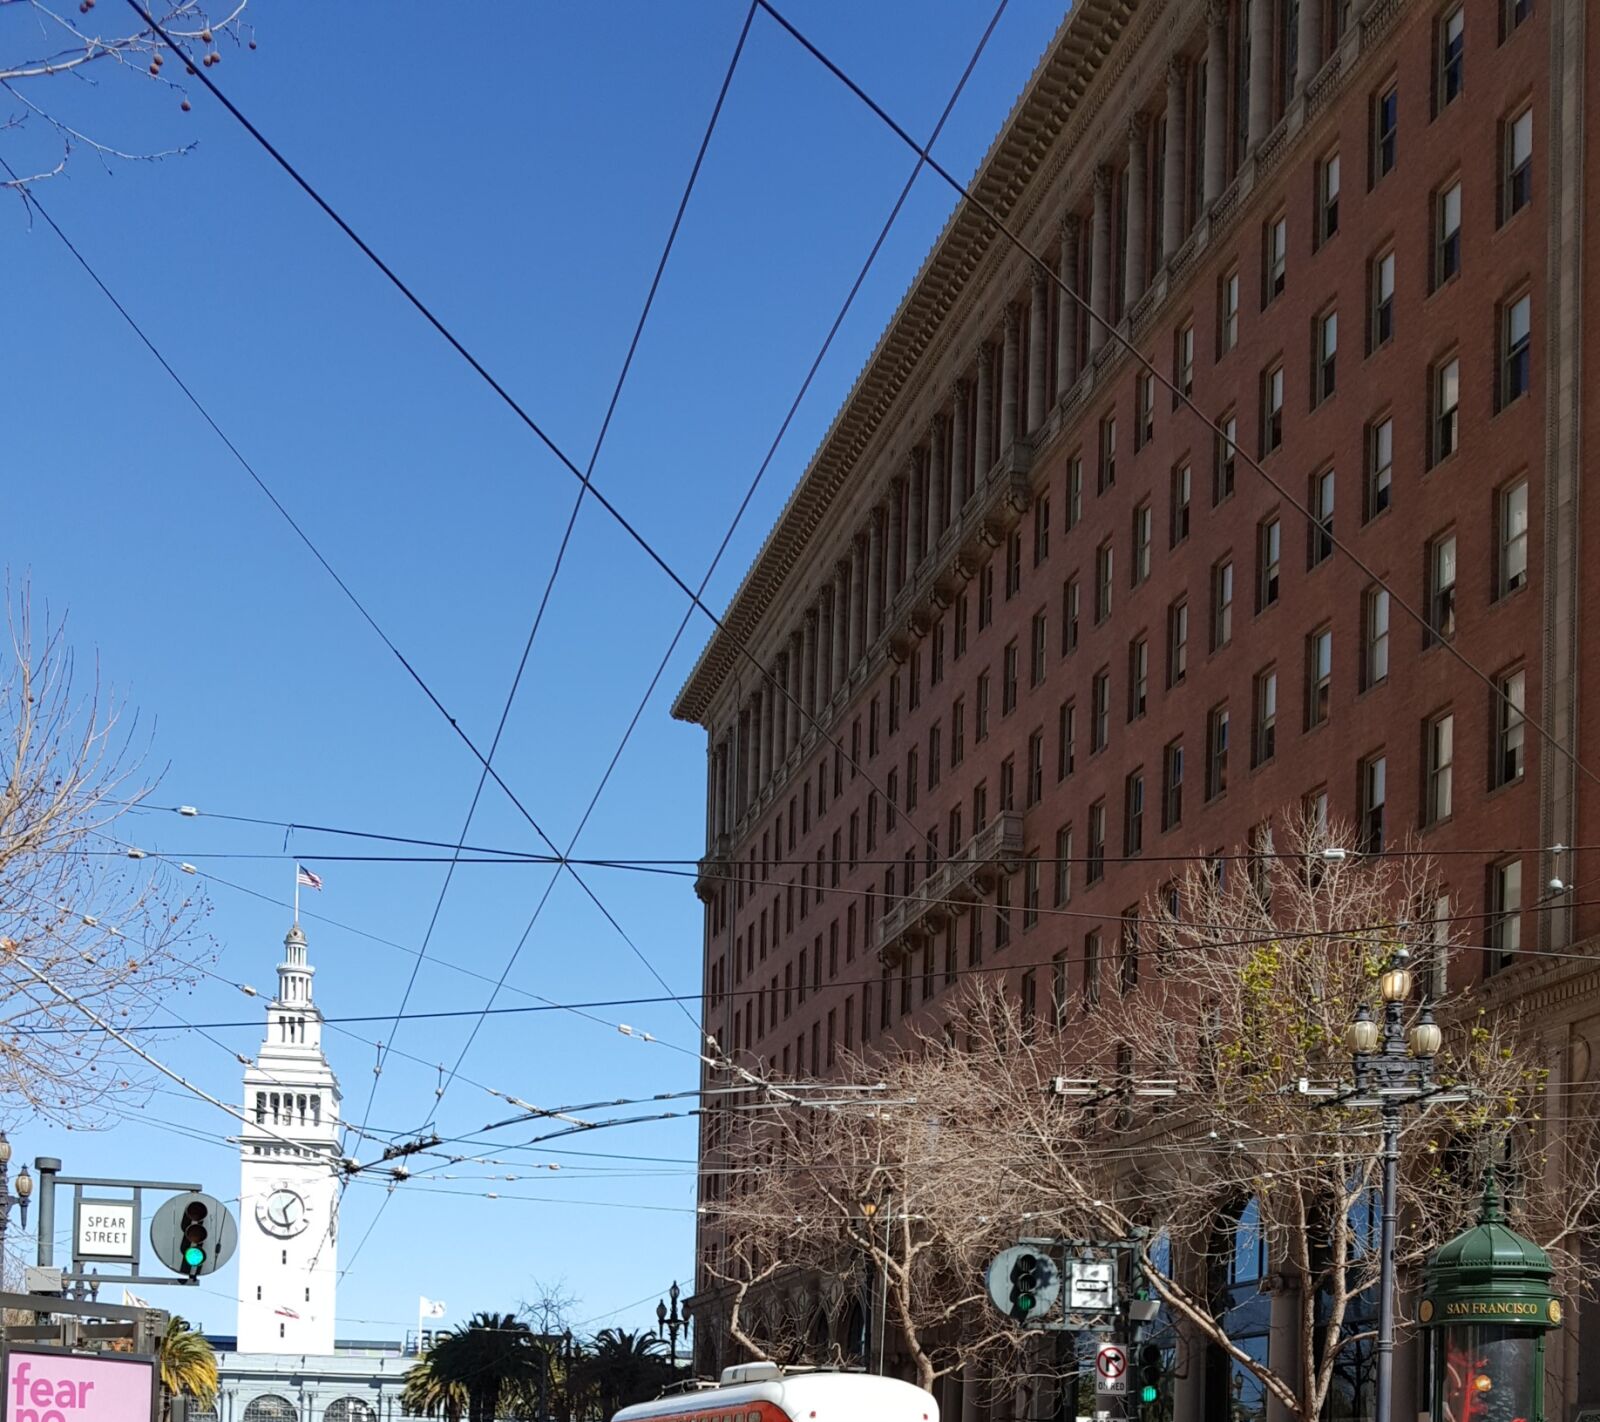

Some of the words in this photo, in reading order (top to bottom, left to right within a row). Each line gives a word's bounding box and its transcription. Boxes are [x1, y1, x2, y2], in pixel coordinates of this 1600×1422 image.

[88, 1216, 125, 1228] SPEAR
[85, 1231, 127, 1243] STREET
[1447, 1303, 1469, 1314] SAN
[1472, 1303, 1538, 1314] FRANCISCO
[12, 1362, 94, 1408] fear
